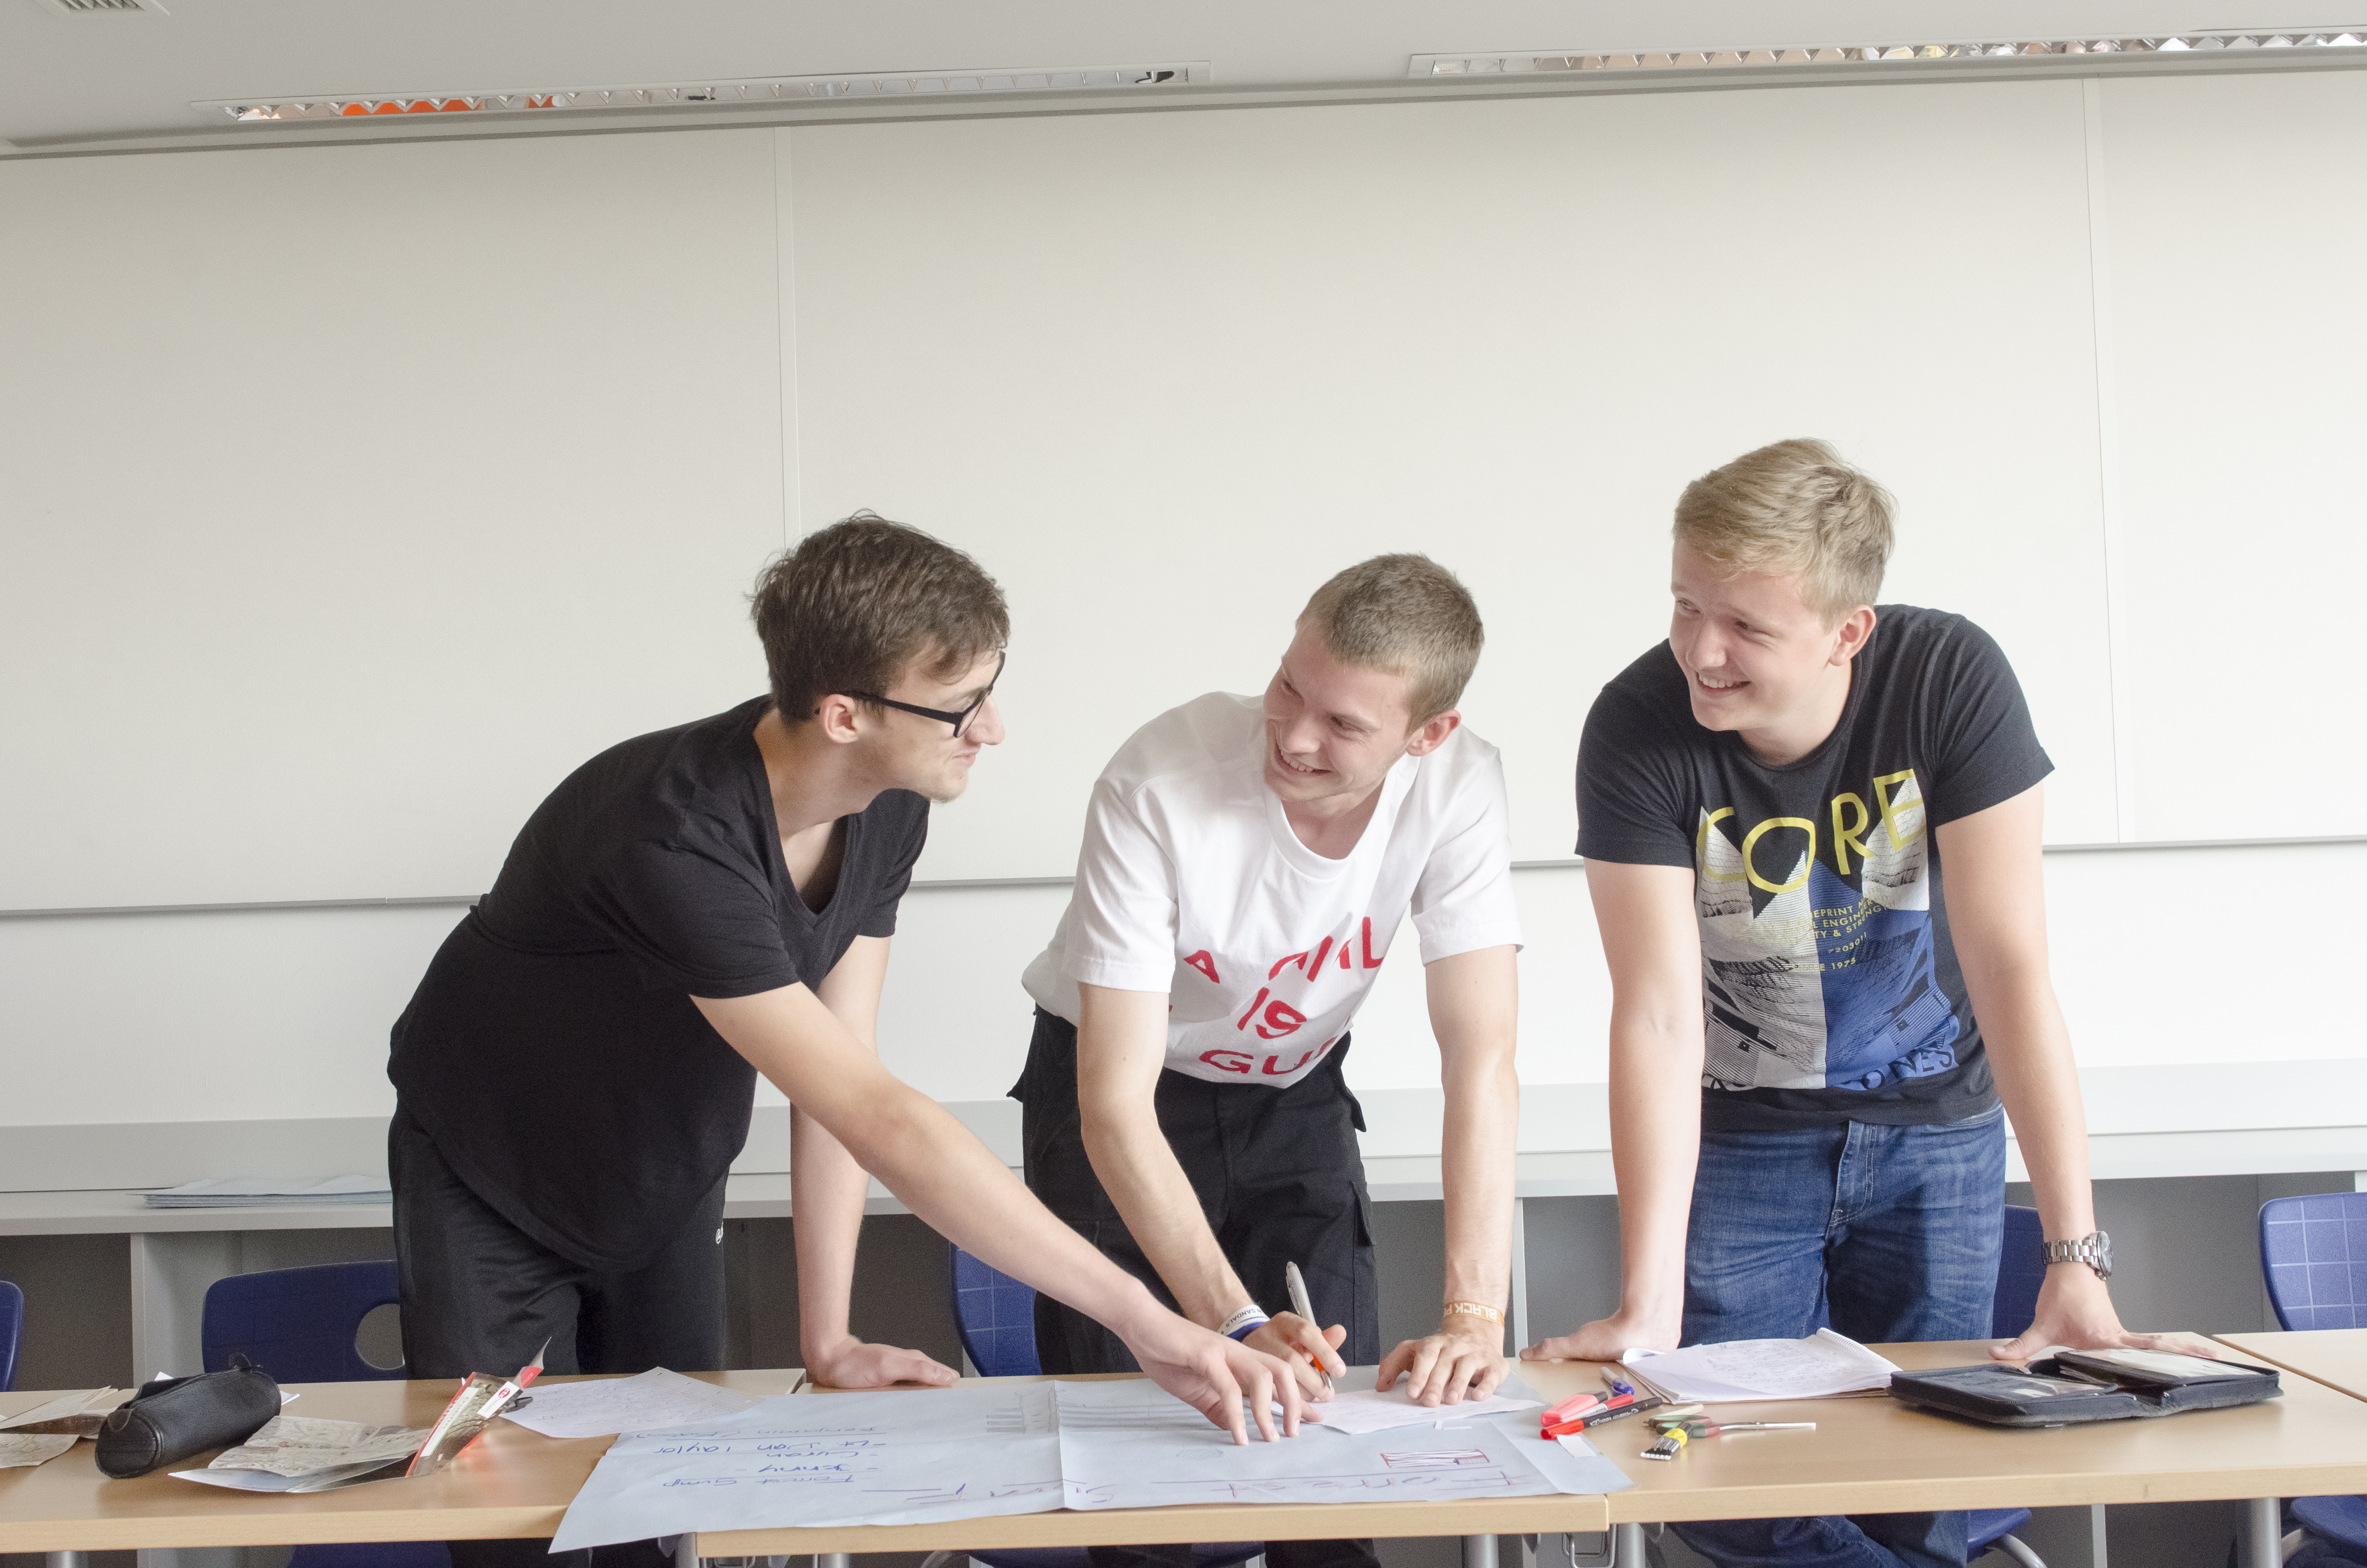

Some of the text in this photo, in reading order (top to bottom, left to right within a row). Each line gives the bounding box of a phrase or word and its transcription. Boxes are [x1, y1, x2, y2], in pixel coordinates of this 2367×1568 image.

[1696, 768, 1926, 893] CORE
[1833, 929, 1842, 937] &
[1831, 956, 1856, 970] 1975
[1237, 987, 1307, 1039] IS
[1225, 1308, 1256, 1328] SANDALS
[1454, 1302, 1497, 1321] BLACK
